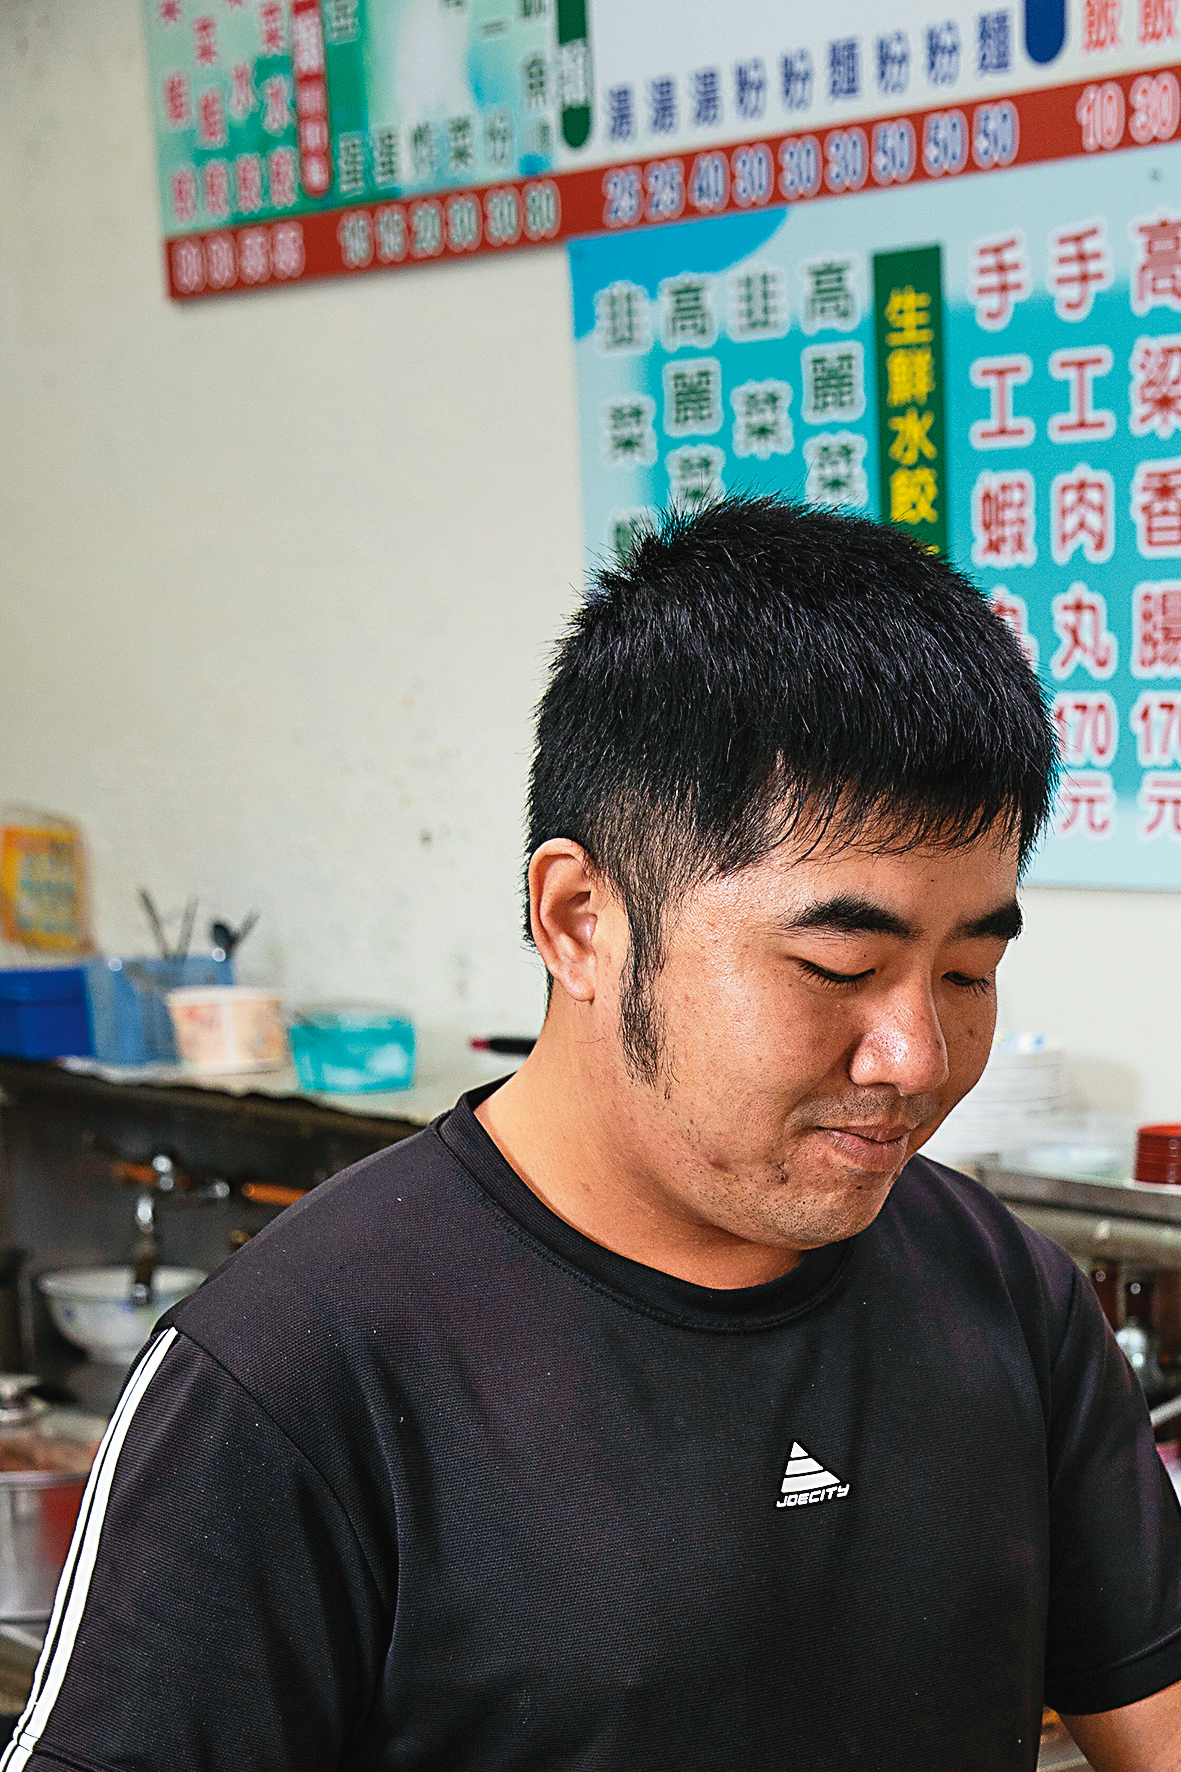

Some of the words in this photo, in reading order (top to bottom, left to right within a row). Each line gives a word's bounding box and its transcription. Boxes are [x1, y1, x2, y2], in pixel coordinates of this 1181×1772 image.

[1079, 85, 1122, 146] 10
[1132, 76, 1178, 139] 30
[1055, 227, 1112, 669] 手工肉丸
[1060, 777, 1111, 833] 元
[776, 1483, 850, 1508] JOECITY
